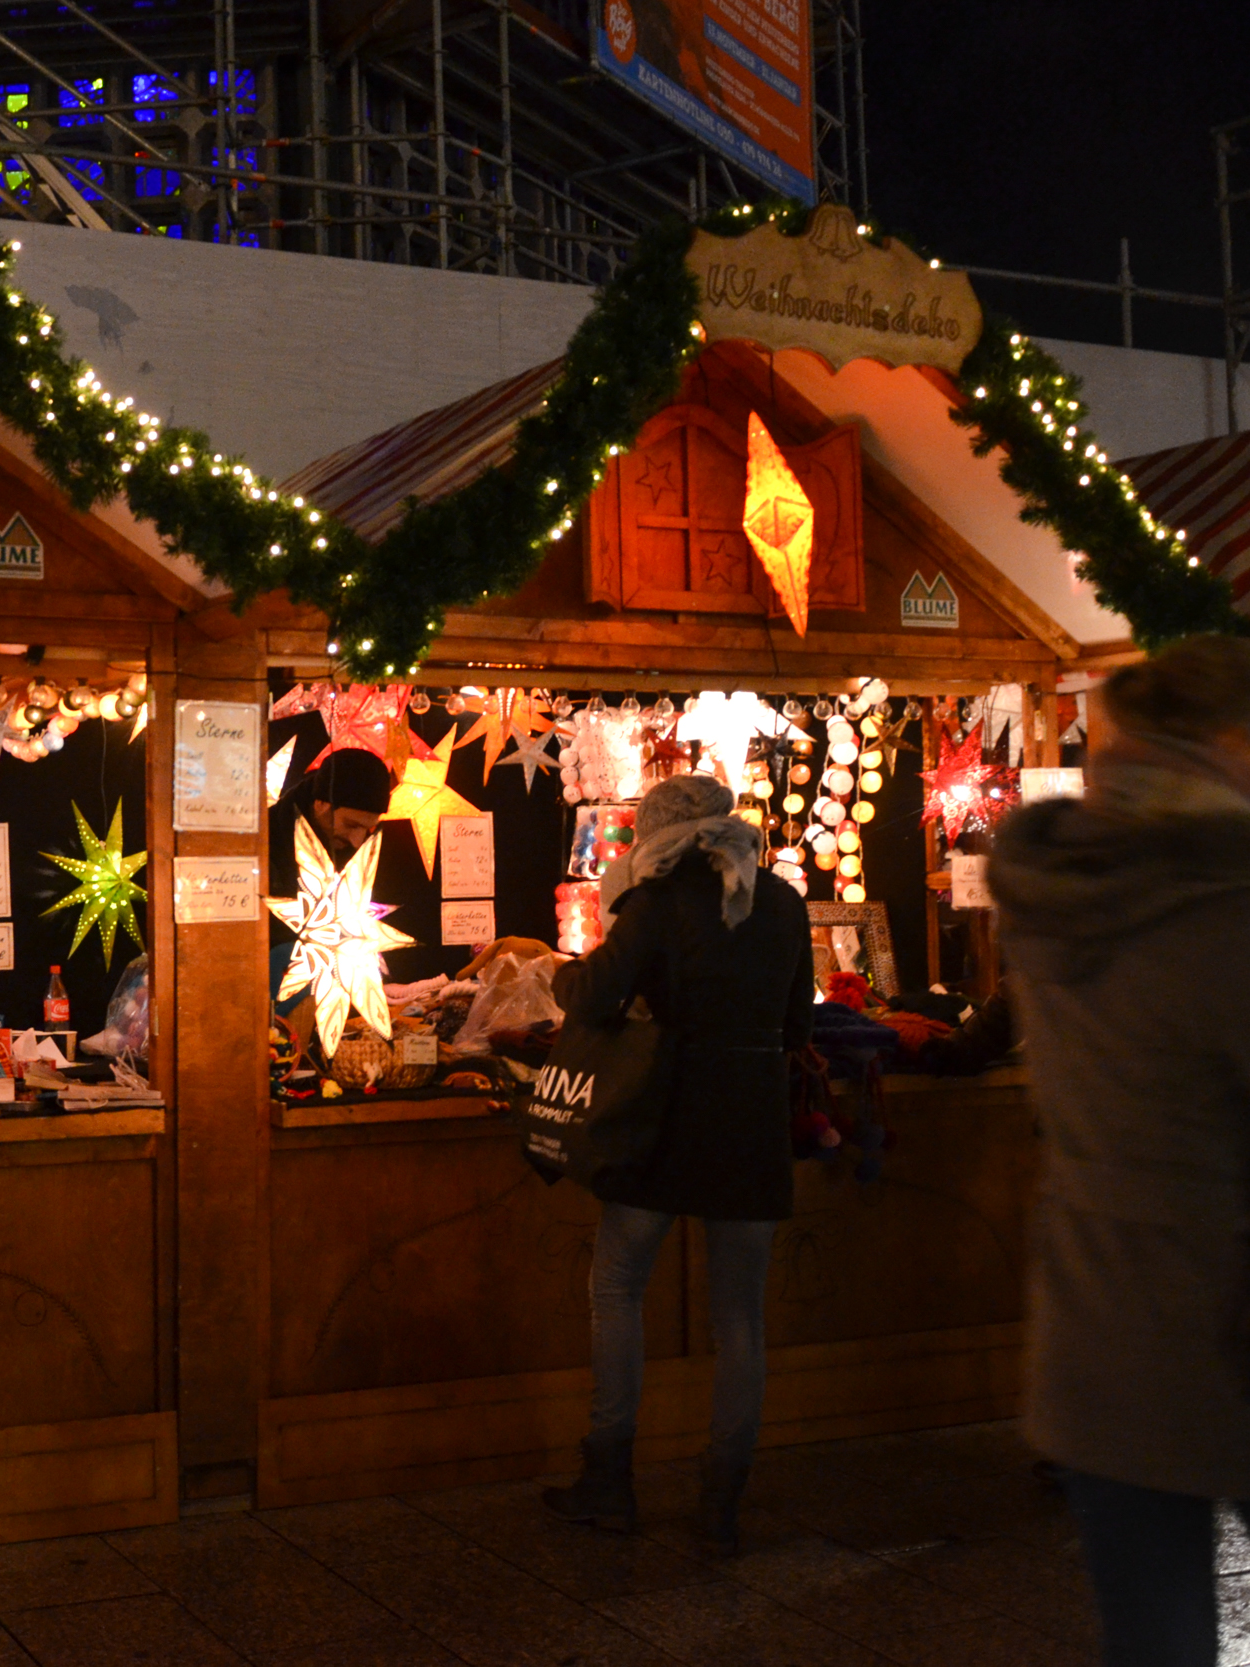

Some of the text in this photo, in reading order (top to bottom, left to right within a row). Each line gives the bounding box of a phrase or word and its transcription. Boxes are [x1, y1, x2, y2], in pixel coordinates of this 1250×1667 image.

[707, 263, 962, 342] Weihnachtsdeko
[903, 600, 957, 616] BLUME
[196, 718, 245, 739] Sterne
[454, 823, 484, 838] Sterne
[223, 894, 237, 907] 15
[240, 894, 250, 908] €
[470, 926, 480, 936] 15
[482, 926, 489, 936] €
